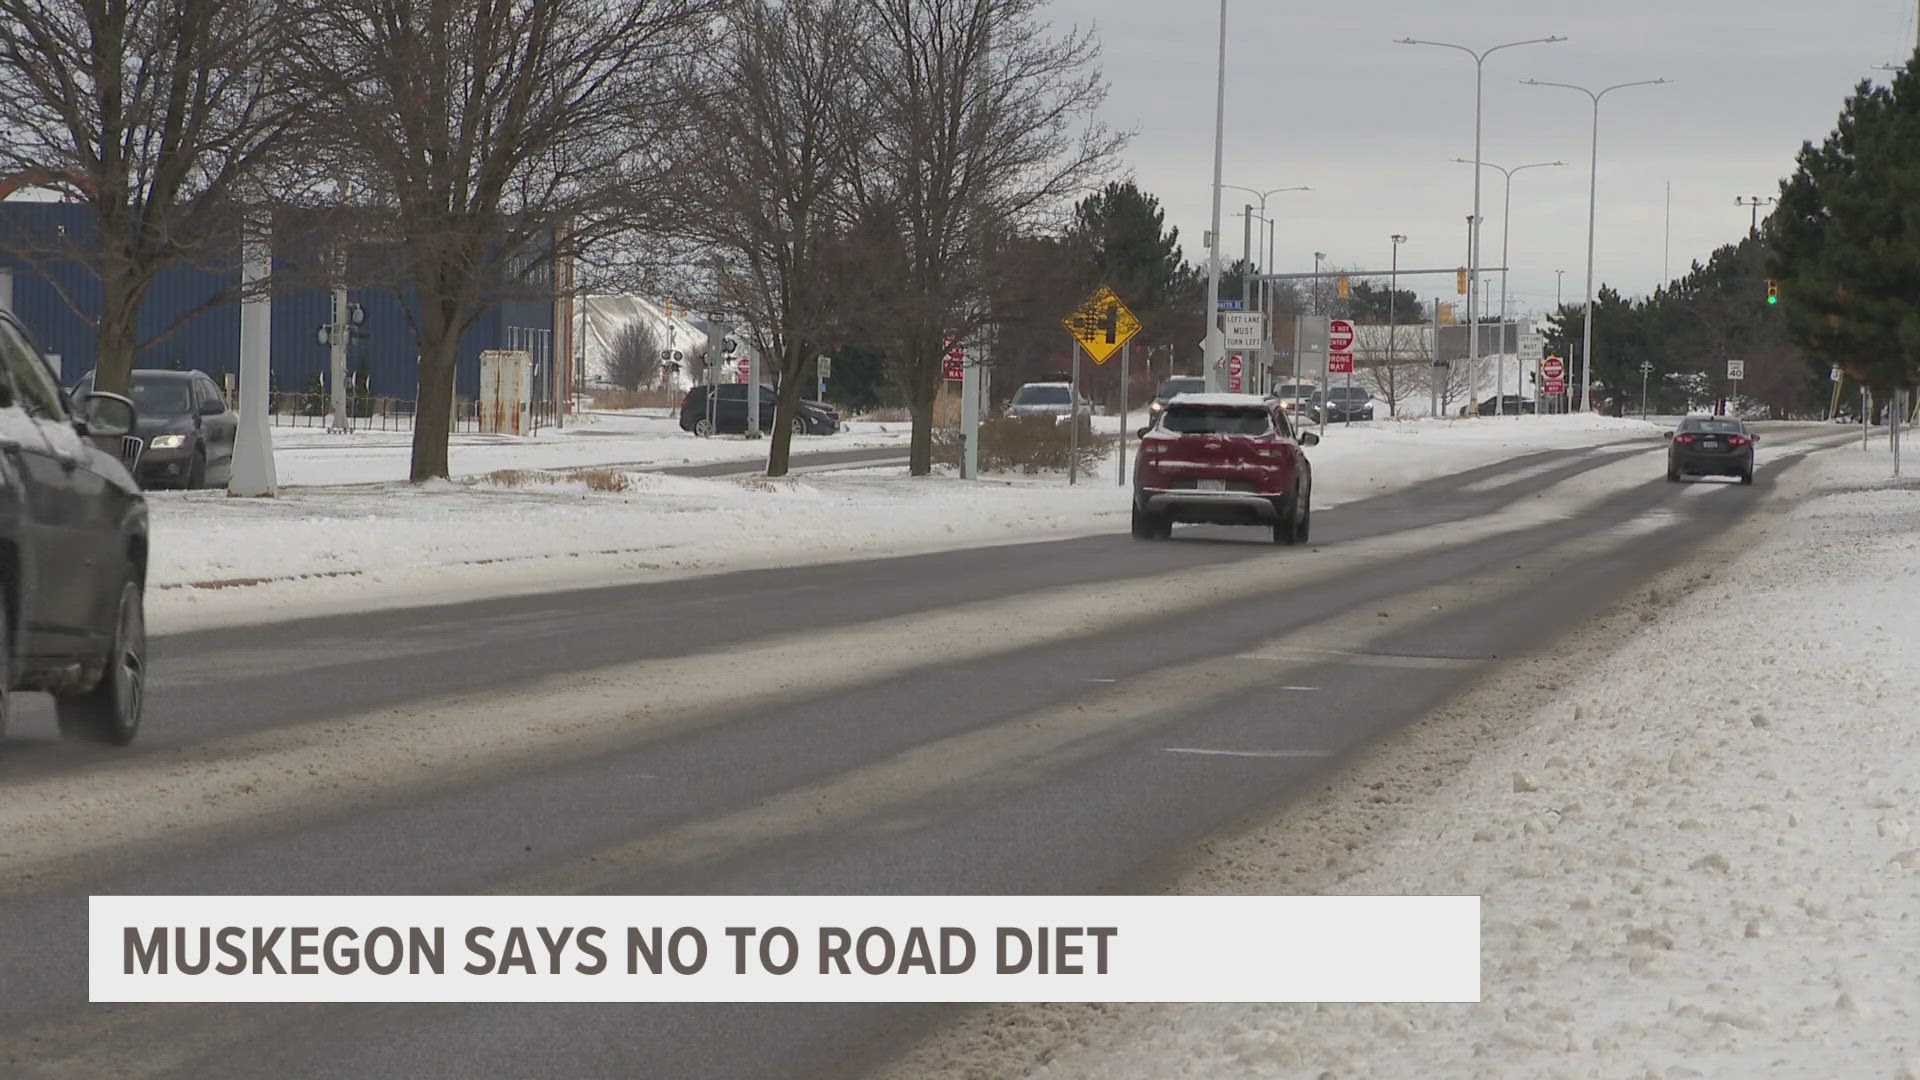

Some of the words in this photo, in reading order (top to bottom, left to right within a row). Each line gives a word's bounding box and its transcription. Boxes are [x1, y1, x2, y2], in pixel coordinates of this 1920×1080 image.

[1233, 327, 1253, 335] MUST
[1227, 338, 1243, 346] TURN
[1245, 338, 1260, 346] LEFT
